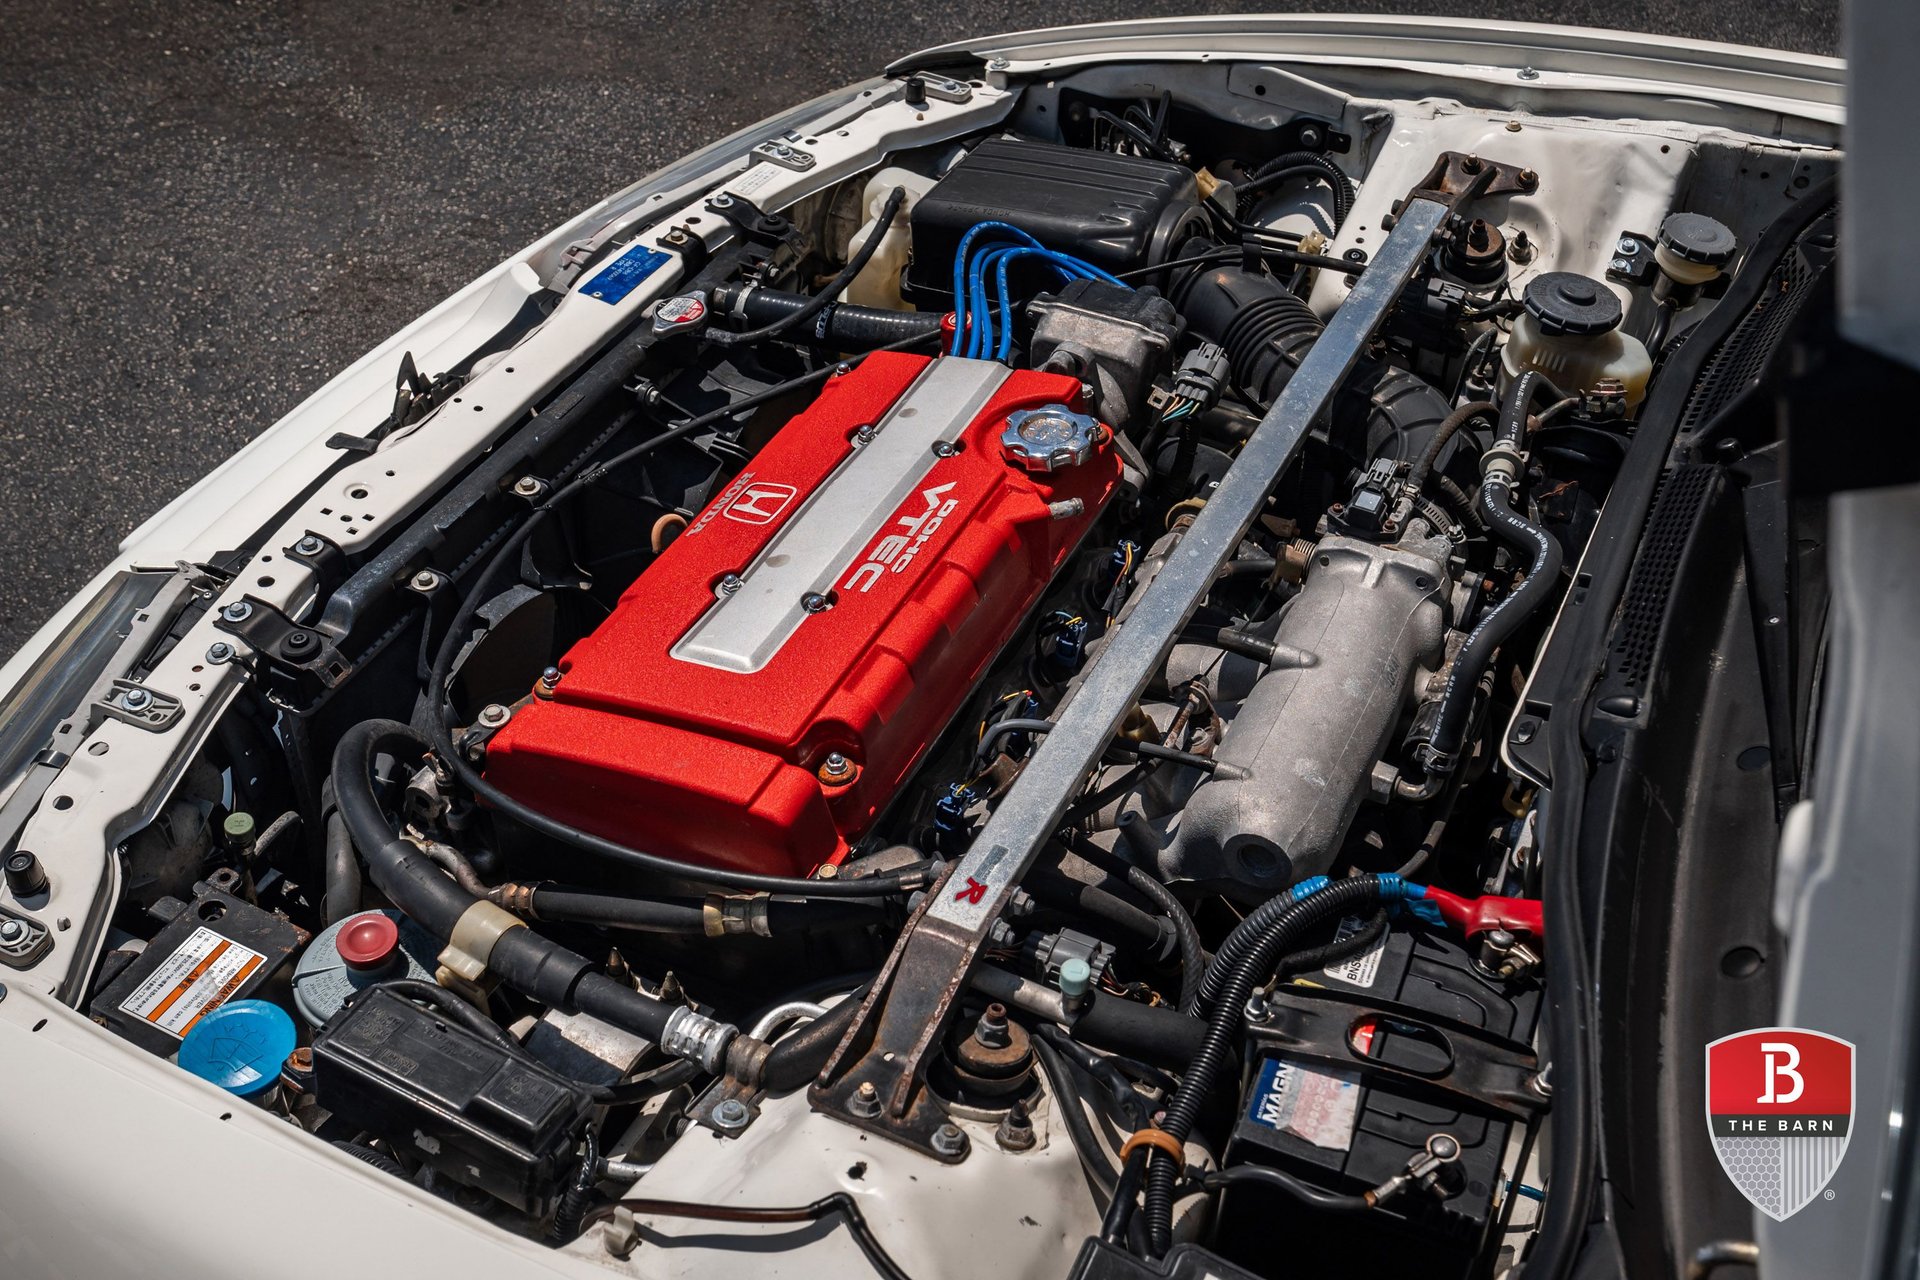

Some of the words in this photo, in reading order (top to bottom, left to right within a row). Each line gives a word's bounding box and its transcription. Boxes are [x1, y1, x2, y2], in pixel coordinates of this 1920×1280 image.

[685, 472, 756, 537] HONDA
[843, 481, 957, 593] VTEC
[891, 498, 959, 573] DOHC
[955, 876, 988, 905] R
[198, 982, 236, 1017] WARNING
